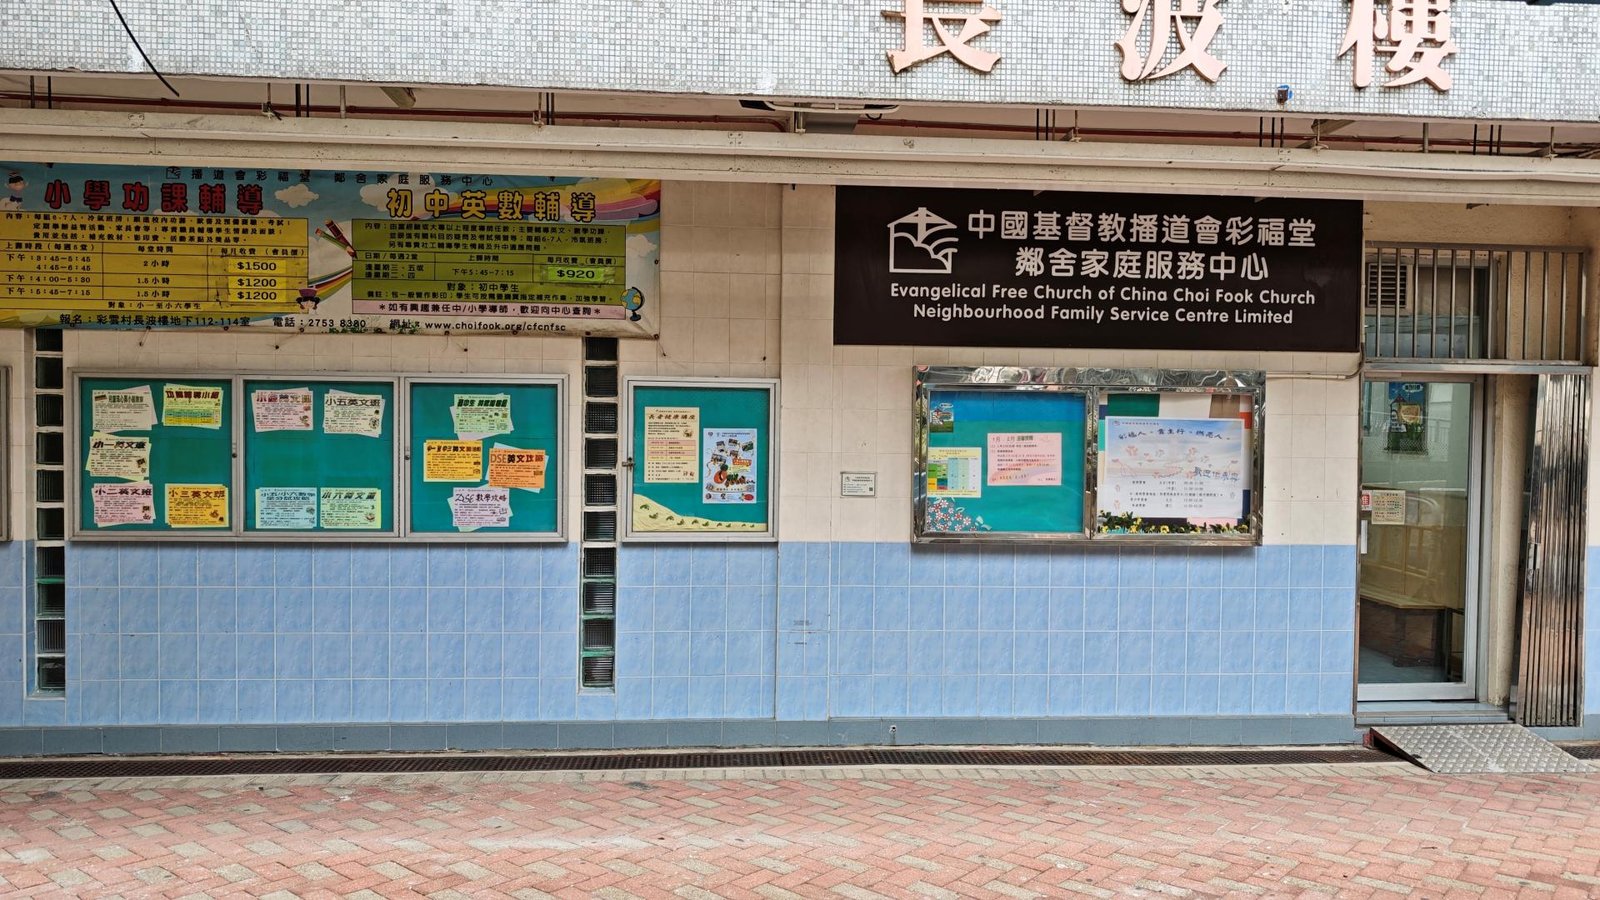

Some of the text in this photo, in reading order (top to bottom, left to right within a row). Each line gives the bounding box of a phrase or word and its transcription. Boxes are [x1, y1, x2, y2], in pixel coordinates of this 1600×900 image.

[44, 179, 263, 215] 小學功課輔導
[387, 188, 596, 222] 初中英數輔導
[968, 209, 1316, 249] 中國基督教播道會彩福堂
[237, 261, 277, 272] $1500
[556, 269, 596, 280] $920
[1015, 246, 1270, 282] 鄰舍家庭服務中心
[237, 278, 277, 288] $1200
[237, 291, 277, 301] $1200
[890, 283, 1316, 305] Evangelical Free Church of China Choi Fook Church
[913, 304, 1294, 324] Neighbourhood Family Service Centre Limited
